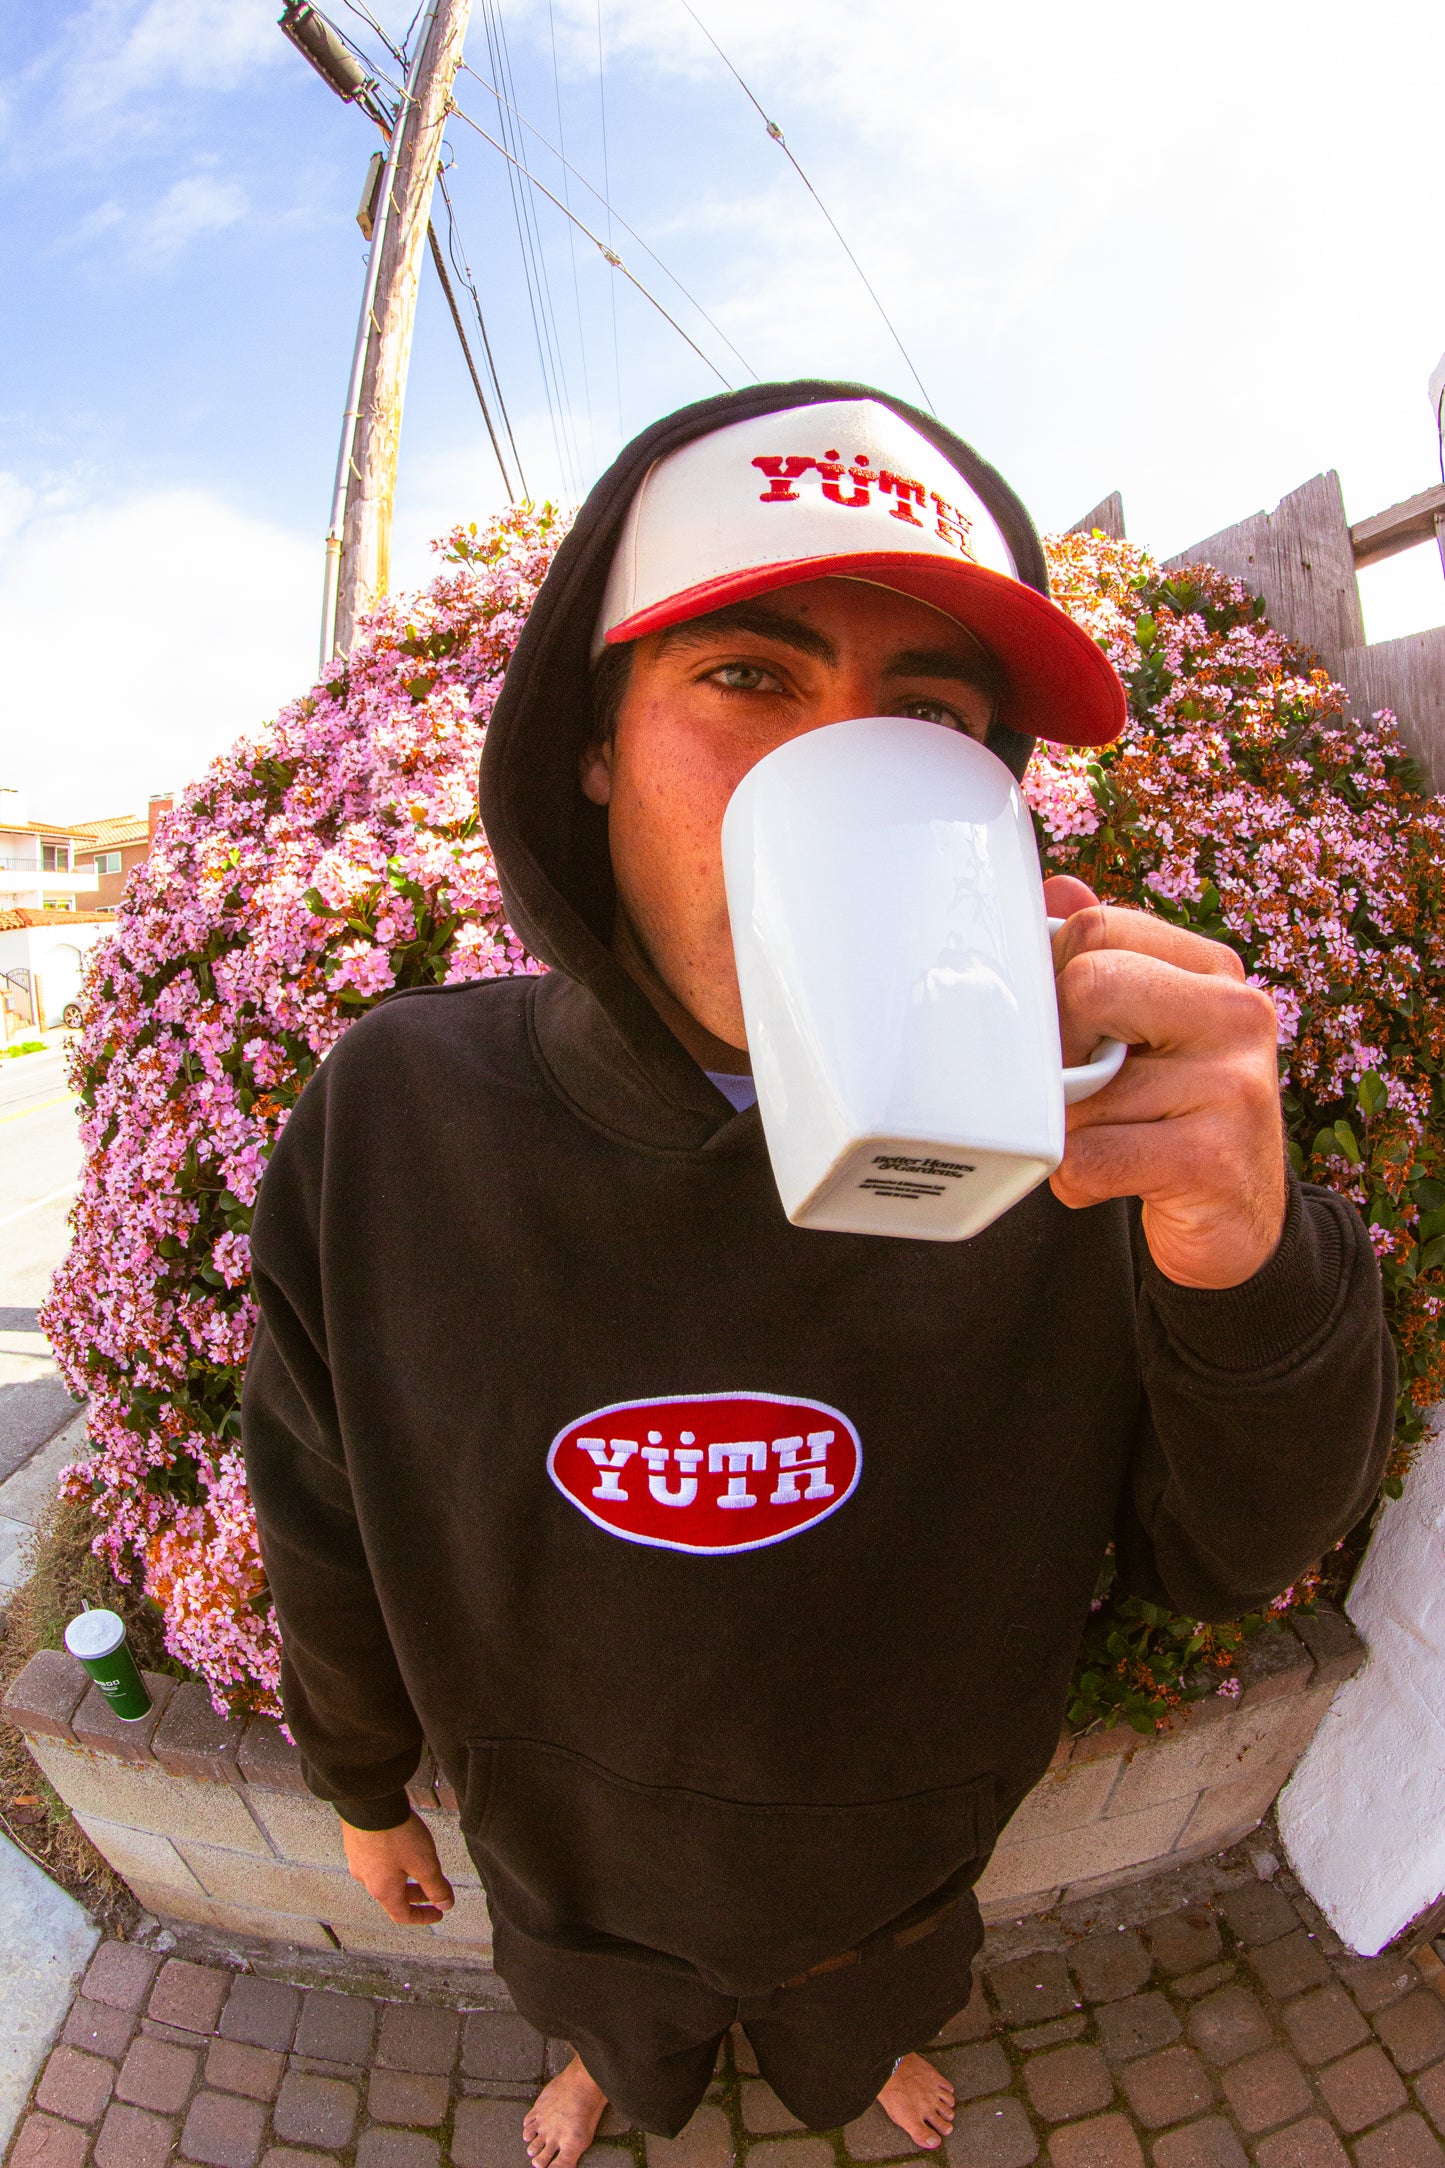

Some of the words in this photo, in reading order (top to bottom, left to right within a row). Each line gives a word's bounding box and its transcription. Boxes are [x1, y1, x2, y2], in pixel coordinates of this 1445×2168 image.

[751, 449, 977, 563] YÜTH
[872, 1155, 921, 1165] Better
[921, 1158, 976, 1172] Homes
[576, 1430, 835, 1509] YÜTH
